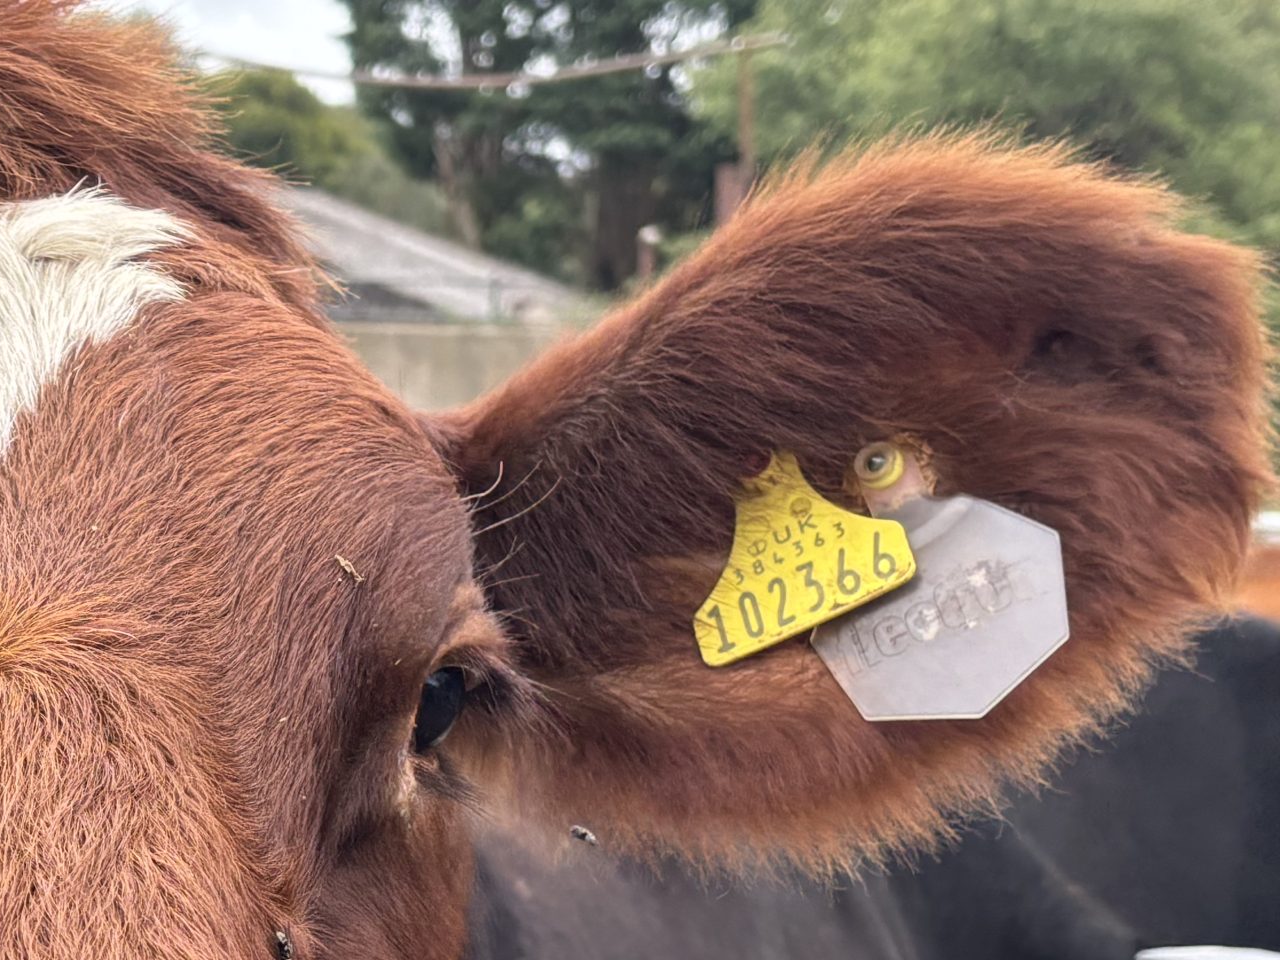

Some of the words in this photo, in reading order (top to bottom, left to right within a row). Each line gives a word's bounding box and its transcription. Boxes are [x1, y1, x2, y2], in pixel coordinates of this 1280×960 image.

[733, 522, 845, 585] 384363
[773, 514, 818, 544] UK
[707, 531, 897, 653] 102366
